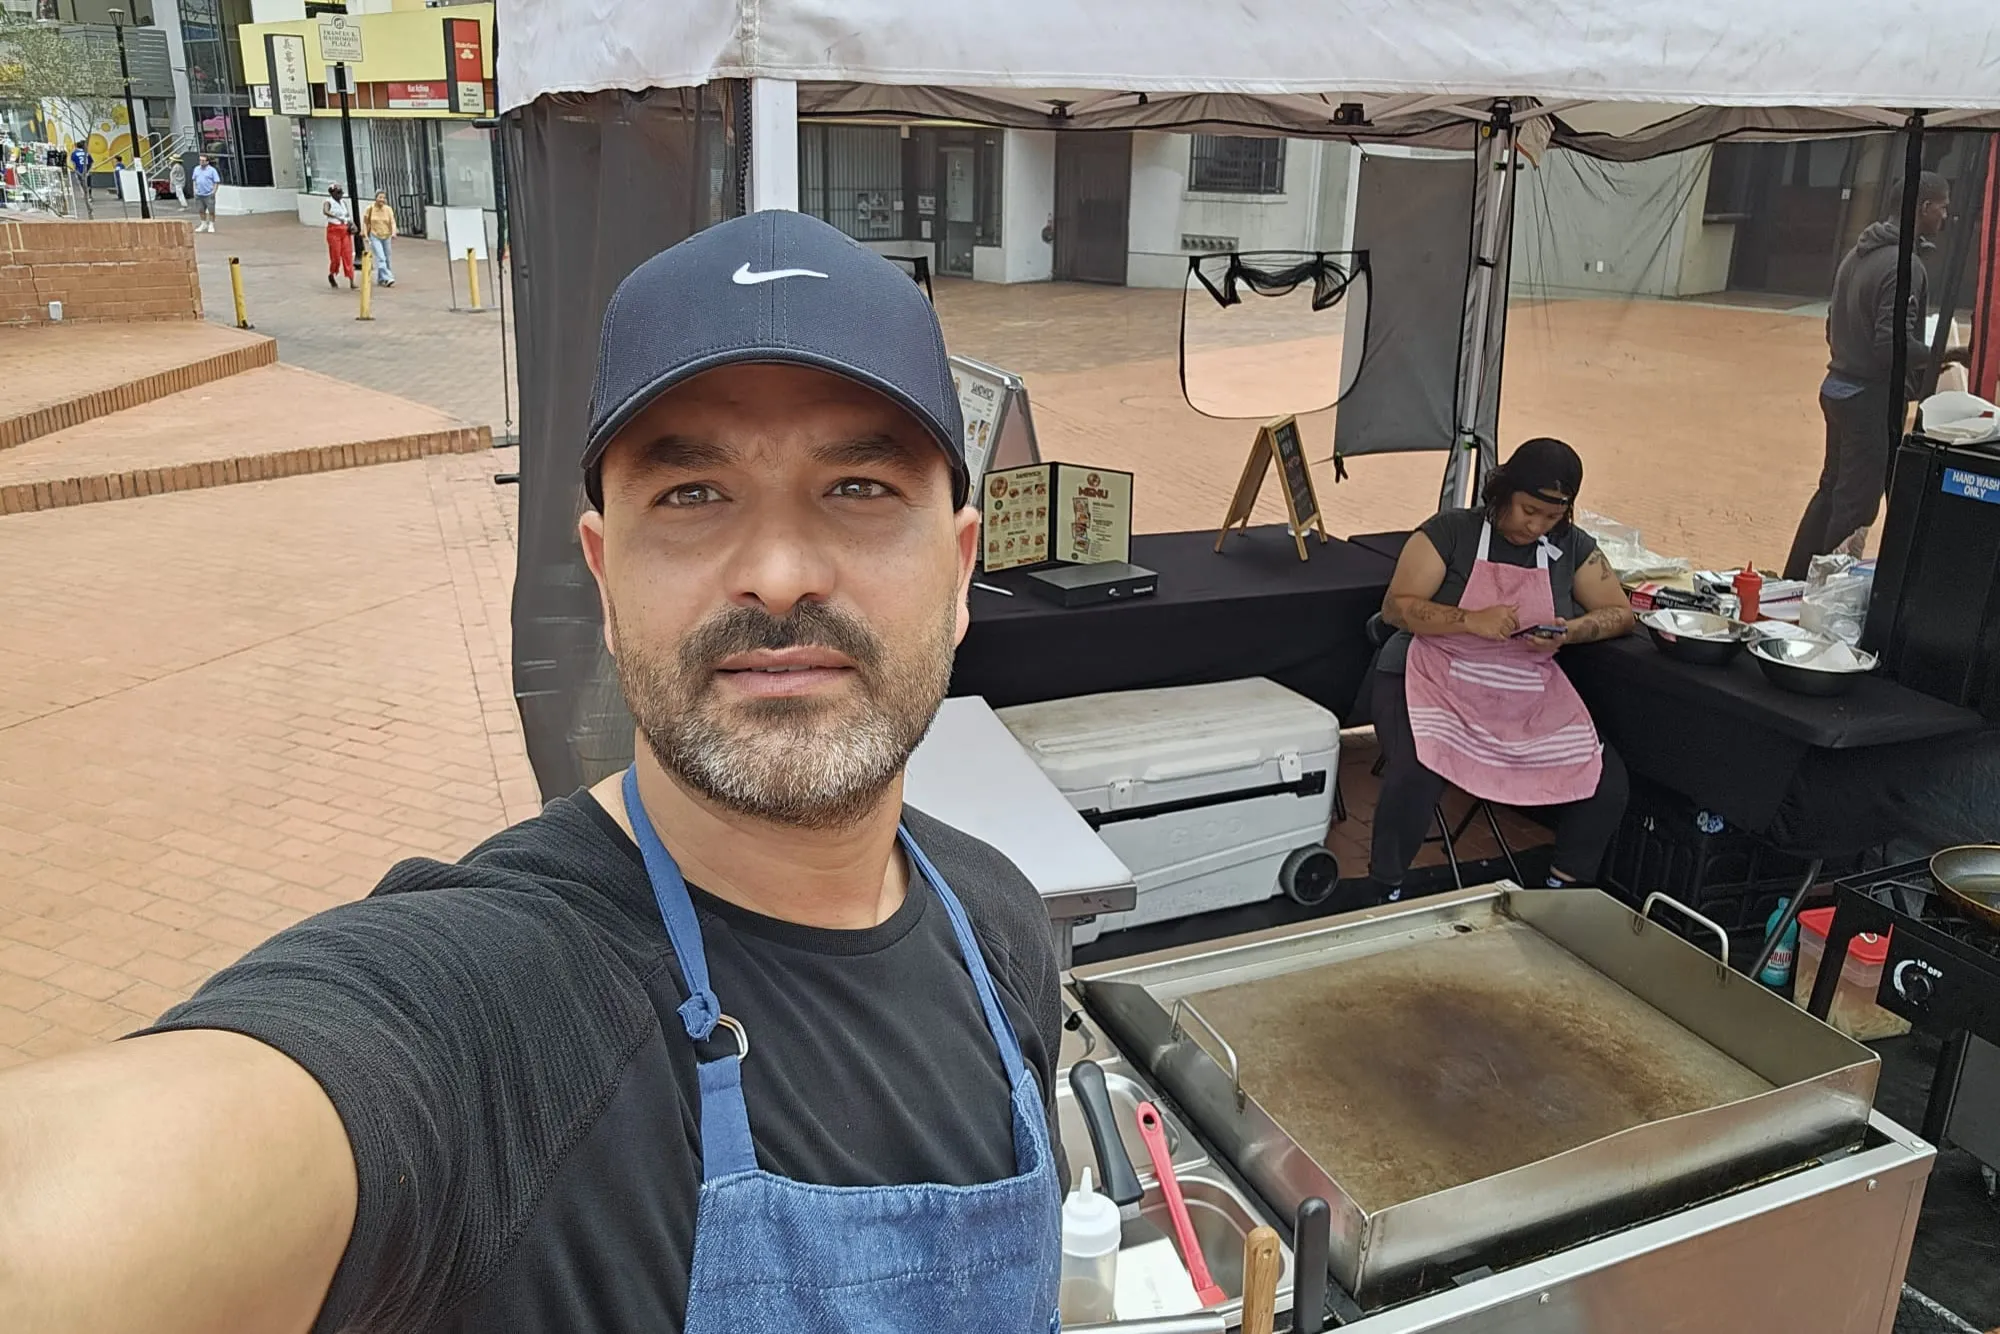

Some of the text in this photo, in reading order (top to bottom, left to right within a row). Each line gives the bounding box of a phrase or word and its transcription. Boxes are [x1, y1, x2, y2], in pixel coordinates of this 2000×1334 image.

[1953, 471, 2000, 491] HAND WASH
[1078, 486, 1109, 499] MENU
[1963, 485, 1986, 499] ONLY
[1927, 966, 1943, 978] OFF
